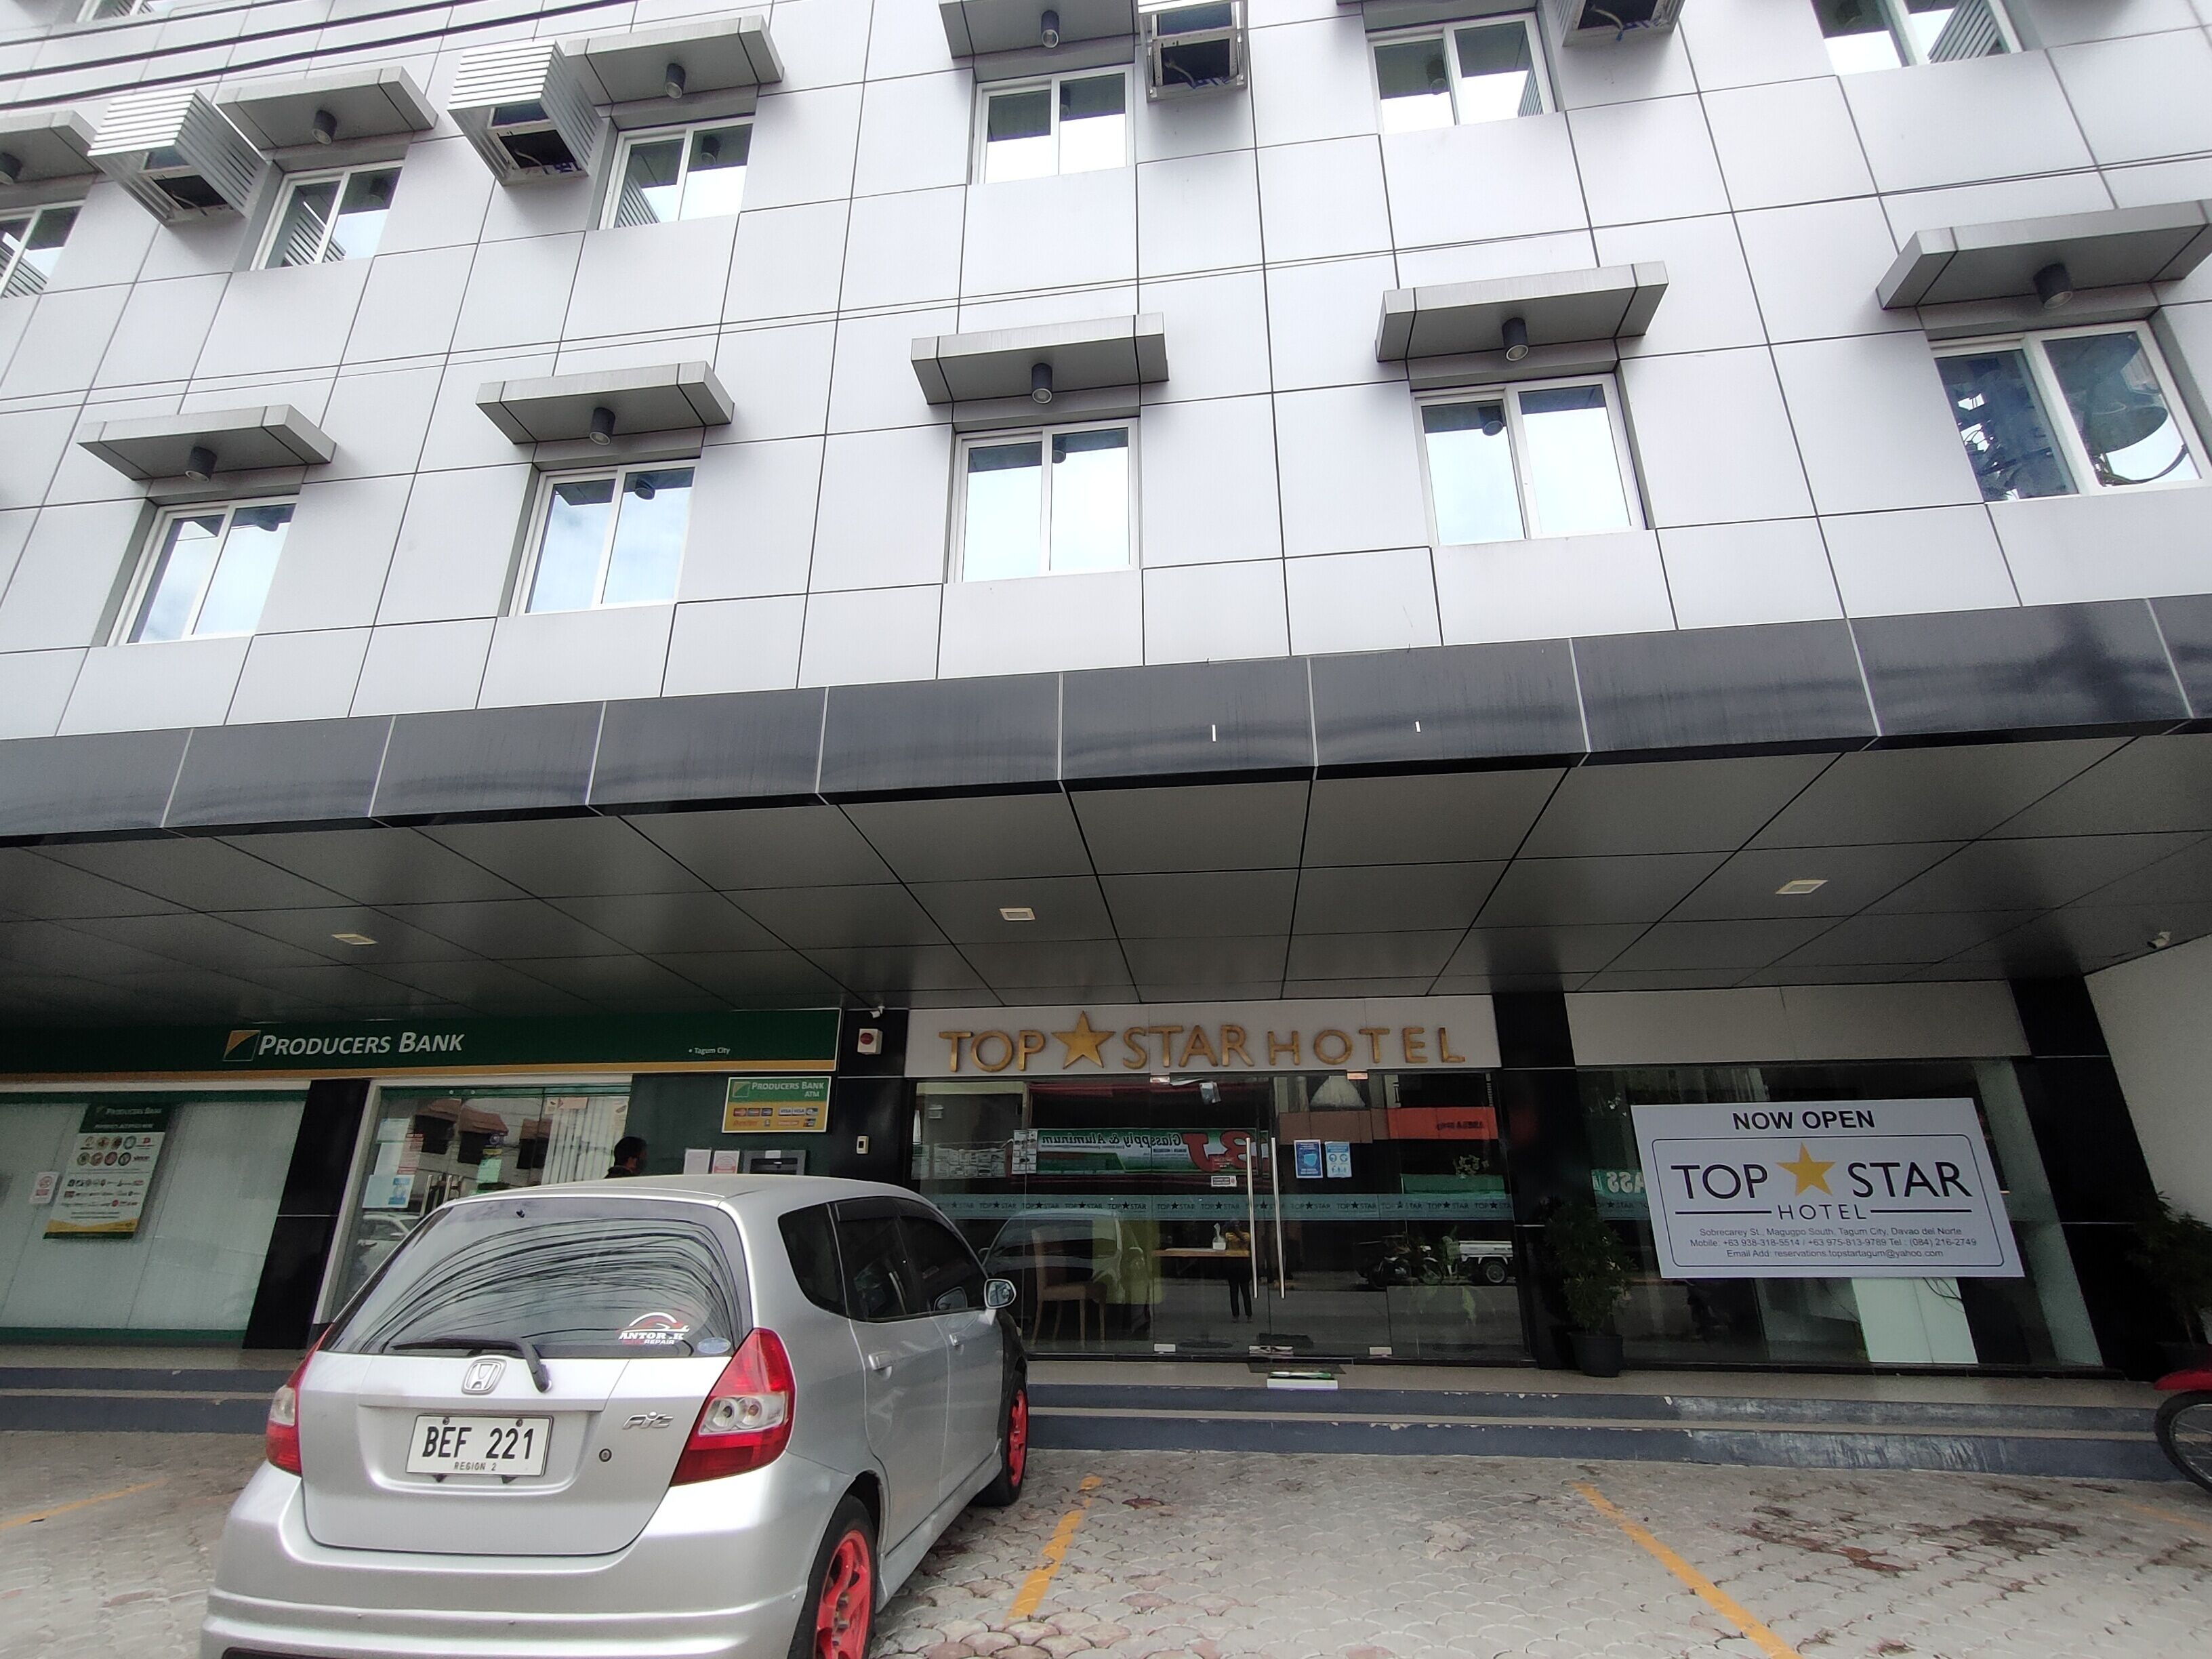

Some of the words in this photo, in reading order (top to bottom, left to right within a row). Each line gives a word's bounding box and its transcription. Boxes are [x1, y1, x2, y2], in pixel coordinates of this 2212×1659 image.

[258, 1035, 392, 1055] PRODUCERS
[398, 1031, 466, 1052] BANK
[939, 1029, 1046, 1073] TOP
[1122, 1024, 1255, 1070] STAR
[1267, 1026, 1467, 1066] HOTEL
[752, 1082, 800, 1090] PRODUCERS
[802, 1082, 825, 1090] BANK
[1732, 1111, 1793, 1130] NOW
[1801, 1109, 1876, 1129] OPEN
[1670, 1164, 1769, 1200] TOP
[1847, 1161, 1973, 1198] STAR
[1778, 1204, 1868, 1221] HOTEL
[1699, 1228, 1748, 1237] Sobrecarey
[1766, 1228, 1807, 1237] Magugpo
[1839, 1227, 1868, 1237] Tagum
[1891, 1227, 1920, 1235] Davao
[1922, 1227, 1936, 1235] del
[1937, 1227, 1963, 1235] Norte
[1723, 1239, 1739, 1247] +63
[1741, 1239, 1800, 1247] 938-318-5514
[1808, 1239, 1824, 1247] +63
[1826, 1238, 1887, 1246] 975-813-9789
[1909, 1238, 1933, 1248] (084)
[1935, 1238, 1978, 1246] 216-2749
[1726, 1250, 1751, 1258] Email
[422, 1426, 472, 1458] BEF
[485, 1427, 534, 1460] 221
[453, 1462, 486, 1471] REGION
[491, 1463, 497, 1471] 2
